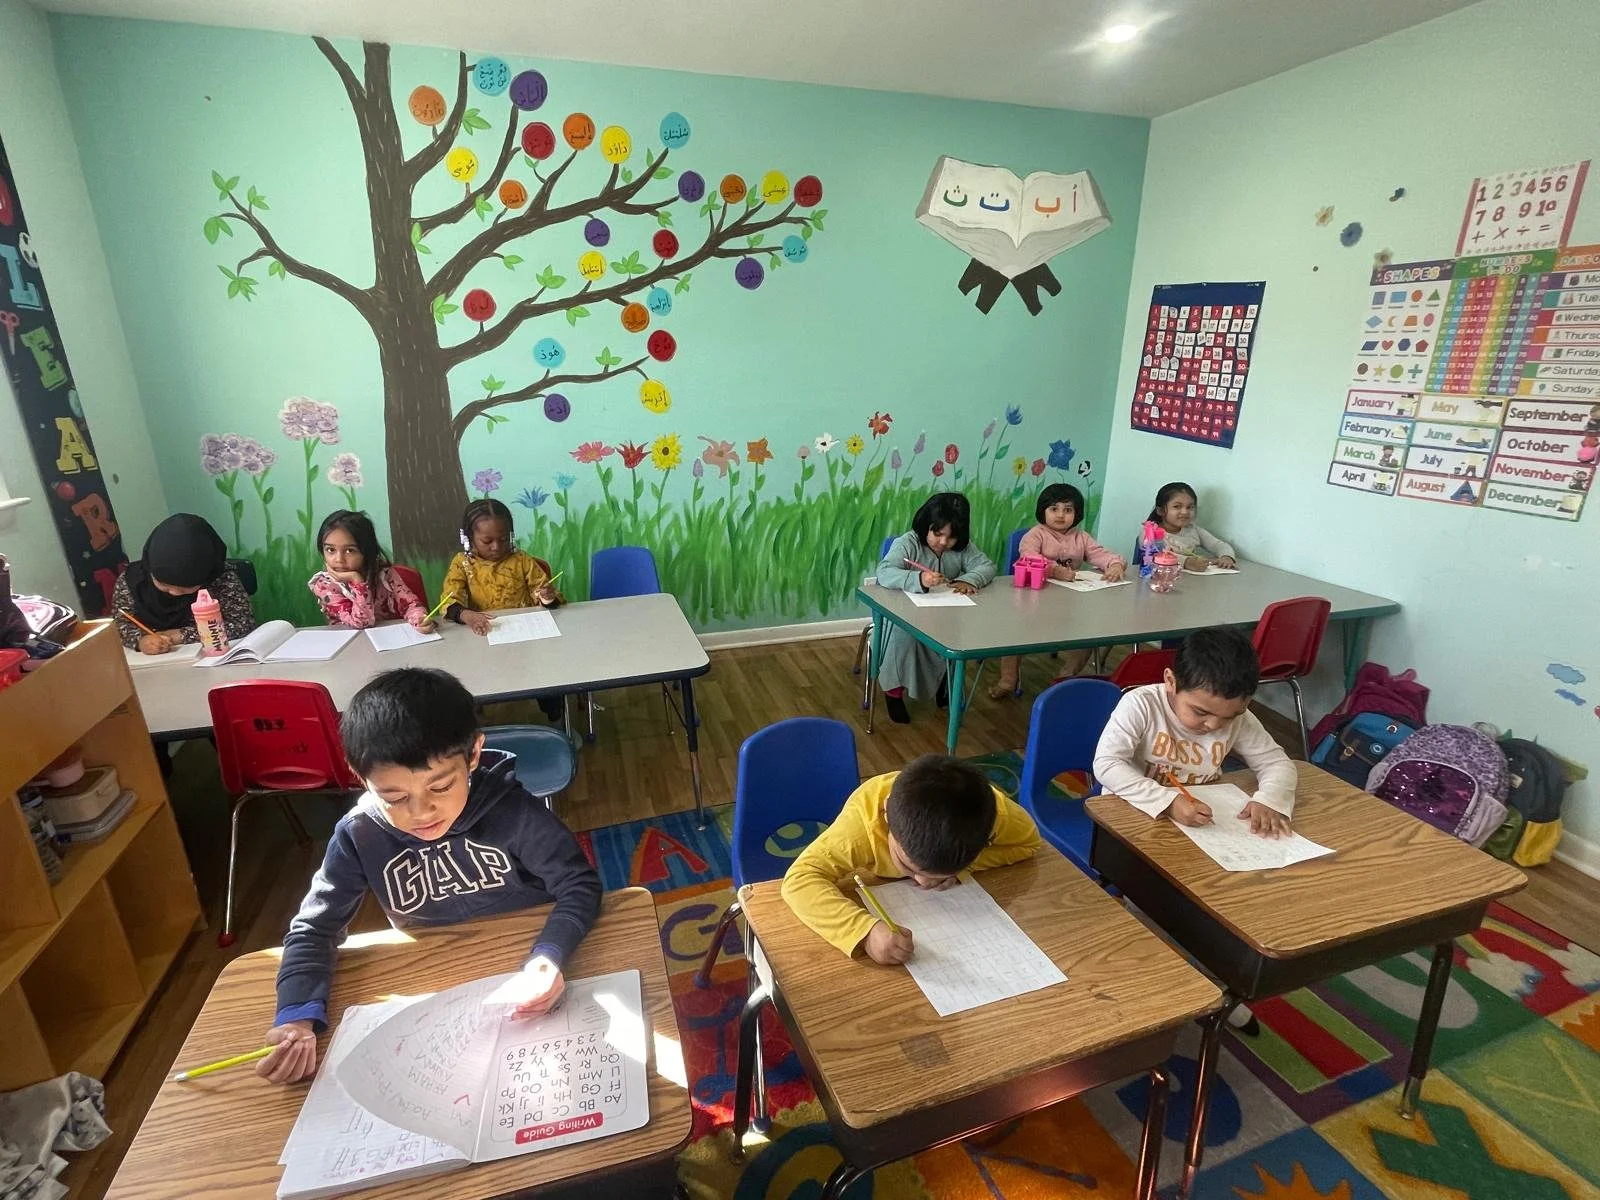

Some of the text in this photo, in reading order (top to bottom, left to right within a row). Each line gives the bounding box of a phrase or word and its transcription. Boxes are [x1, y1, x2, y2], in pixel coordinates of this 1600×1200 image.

[1476, 175, 1568, 202] 1 2 3 4 5 6
[943, 185, 968, 207] ث
[979, 193, 1010, 212] ت
[1034, 196, 1060, 219] ب
[1475, 210, 1486, 225] 7
[1492, 206, 1505, 222] 8
[1518, 201, 1531, 218] 9
[1384, 267, 1439, 283] SHAPES
[1578, 293, 1600, 302] Tue
[1552, 384, 1594, 395] Sunday
[1351, 396, 1394, 410] January
[1431, 401, 1459, 415] May
[1509, 407, 1588, 422] September
[1344, 421, 1391, 438] February
[1424, 428, 1453, 441] June
[1507, 438, 1570, 453] October
[1343, 446, 1376, 460] March
[1420, 453, 1443, 467] July
[1341, 470, 1366, 482] April
[1495, 463, 1572, 481] November
[1406, 478, 1446, 493] August
[1487, 488, 1561, 508] December
[207, 618, 222, 652] MINNIE
[383, 837, 512, 915] GAP
[566, 1039, 573, 1047] 4
[577, 1036, 584, 1045] 3
[589, 1033, 596, 1042] 2
[530, 1046, 537, 1055] 7
[542, 1043, 550, 1052] 6
[554, 1040, 560, 1049] 5
[506, 1051, 514, 1060] 9
[518, 1048, 526, 1058] 8
[576, 1046, 598, 1056] Ww
[531, 1055, 544, 1066] Yy
[580, 1059, 591, 1068] Rr
[600, 1053, 620, 1063] Qq
[509, 1061, 523, 1071] Zz
[514, 1072, 530, 1082] Uu
[579, 1070, 602, 1080] Mm
[551, 1076, 570, 1087] Nn
[610, 1080, 620, 1091] Ff
[501, 1088, 516, 1098] Pp
[521, 1083, 542, 1093] Oo
[581, 1084, 600, 1094] Gg
[554, 1090, 572, 1102] Hh
[499, 1102, 514, 1115] Kk
[520, 1097, 530, 1110] Jj
[500, 1094, 622, 1128] Aa Bb Cc Dd Ee
[523, 1117, 597, 1140] Writing Guide
